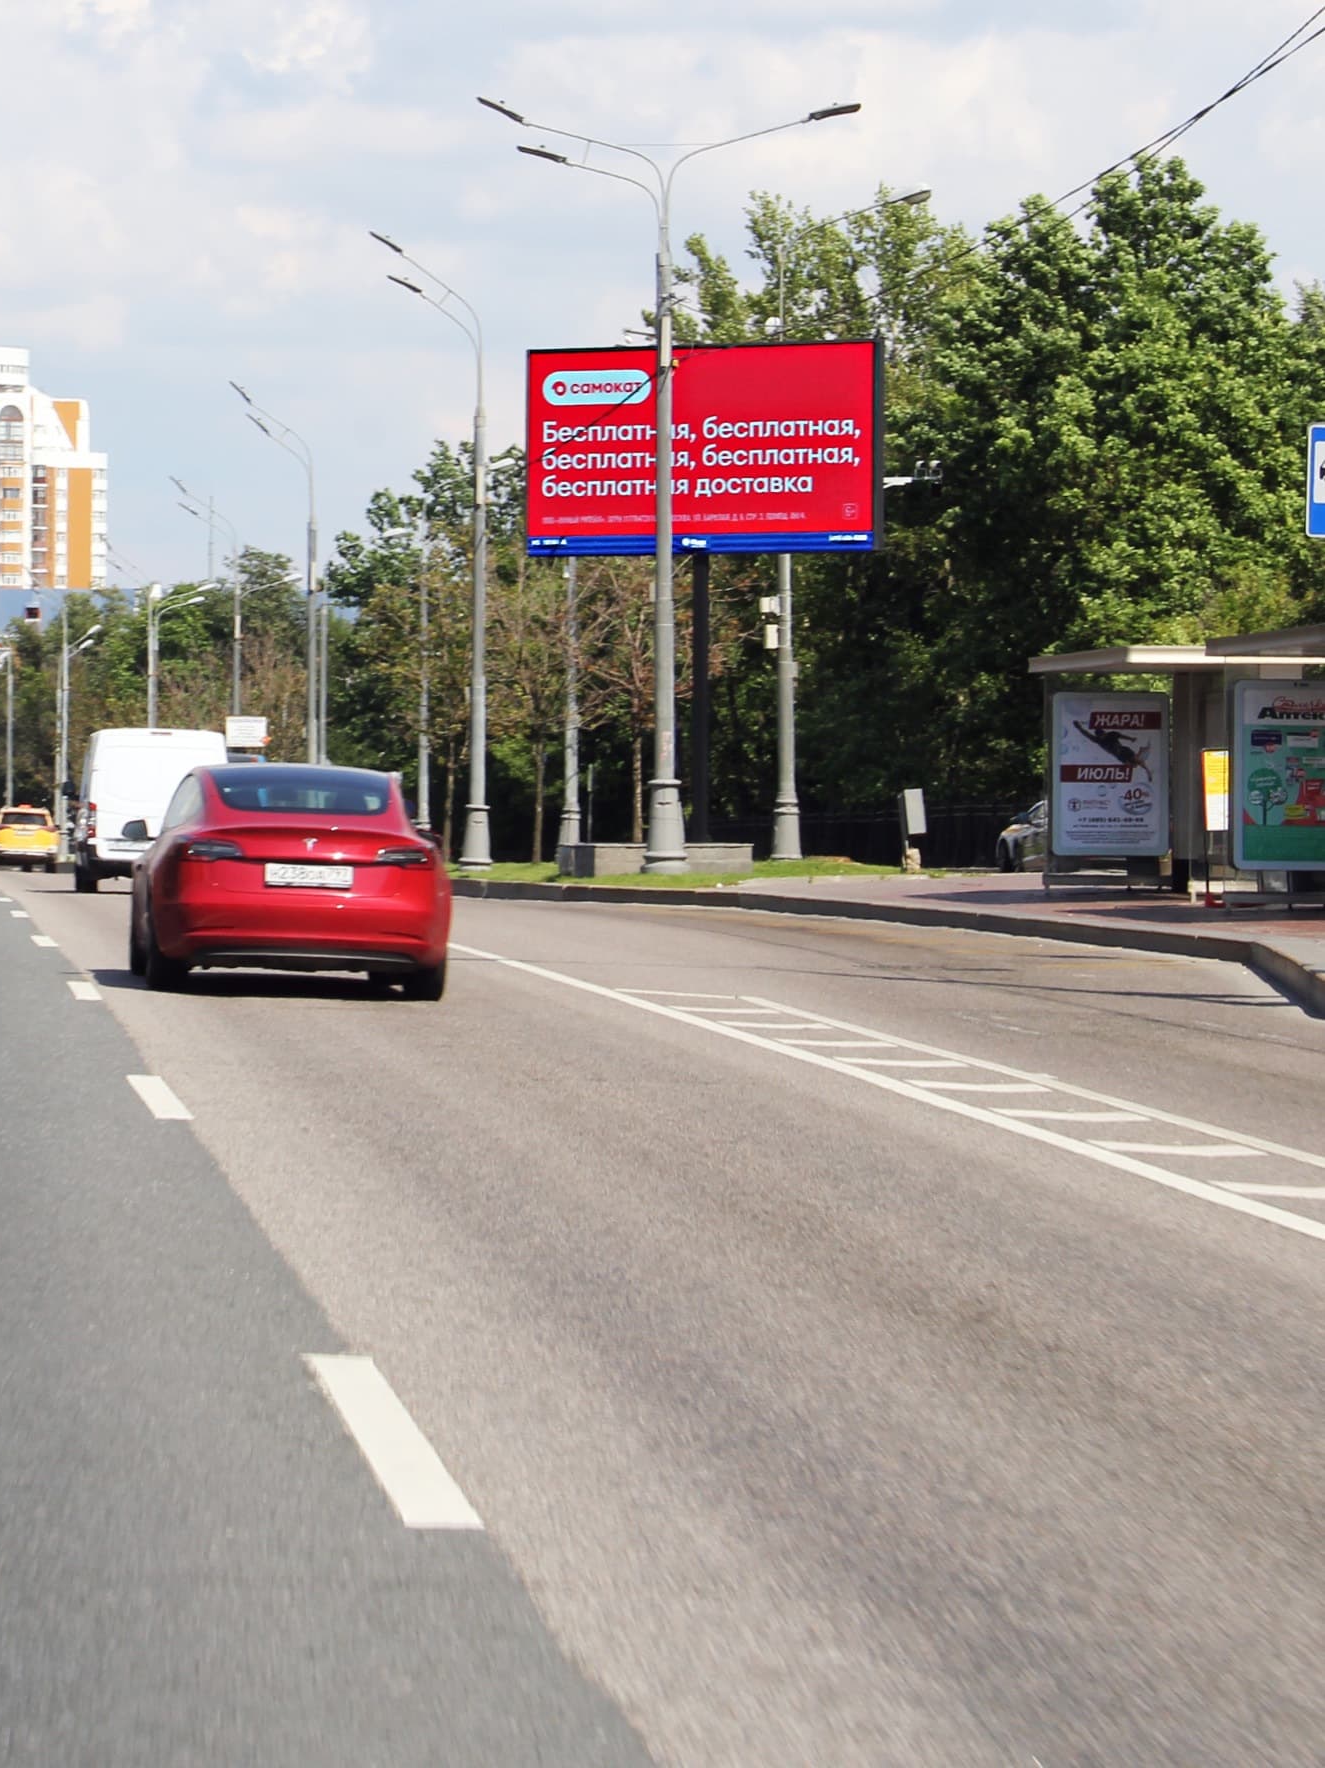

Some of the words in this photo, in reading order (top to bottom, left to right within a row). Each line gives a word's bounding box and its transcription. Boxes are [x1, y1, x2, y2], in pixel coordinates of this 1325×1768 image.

[570, 382, 643, 394] самокат
[542, 420, 696, 443] Бесплатня,
[702, 416, 861, 439] бесплатная,
[541, 448, 696, 471] бесплатня,
[702, 444, 861, 467] бесплатная,
[541, 475, 689, 497] бесплатня
[694, 476, 813, 498] доставка
[1094, 714, 1145, 727] ЖАРА!
[1076, 767, 1130, 780] ИЮЛЬ!
